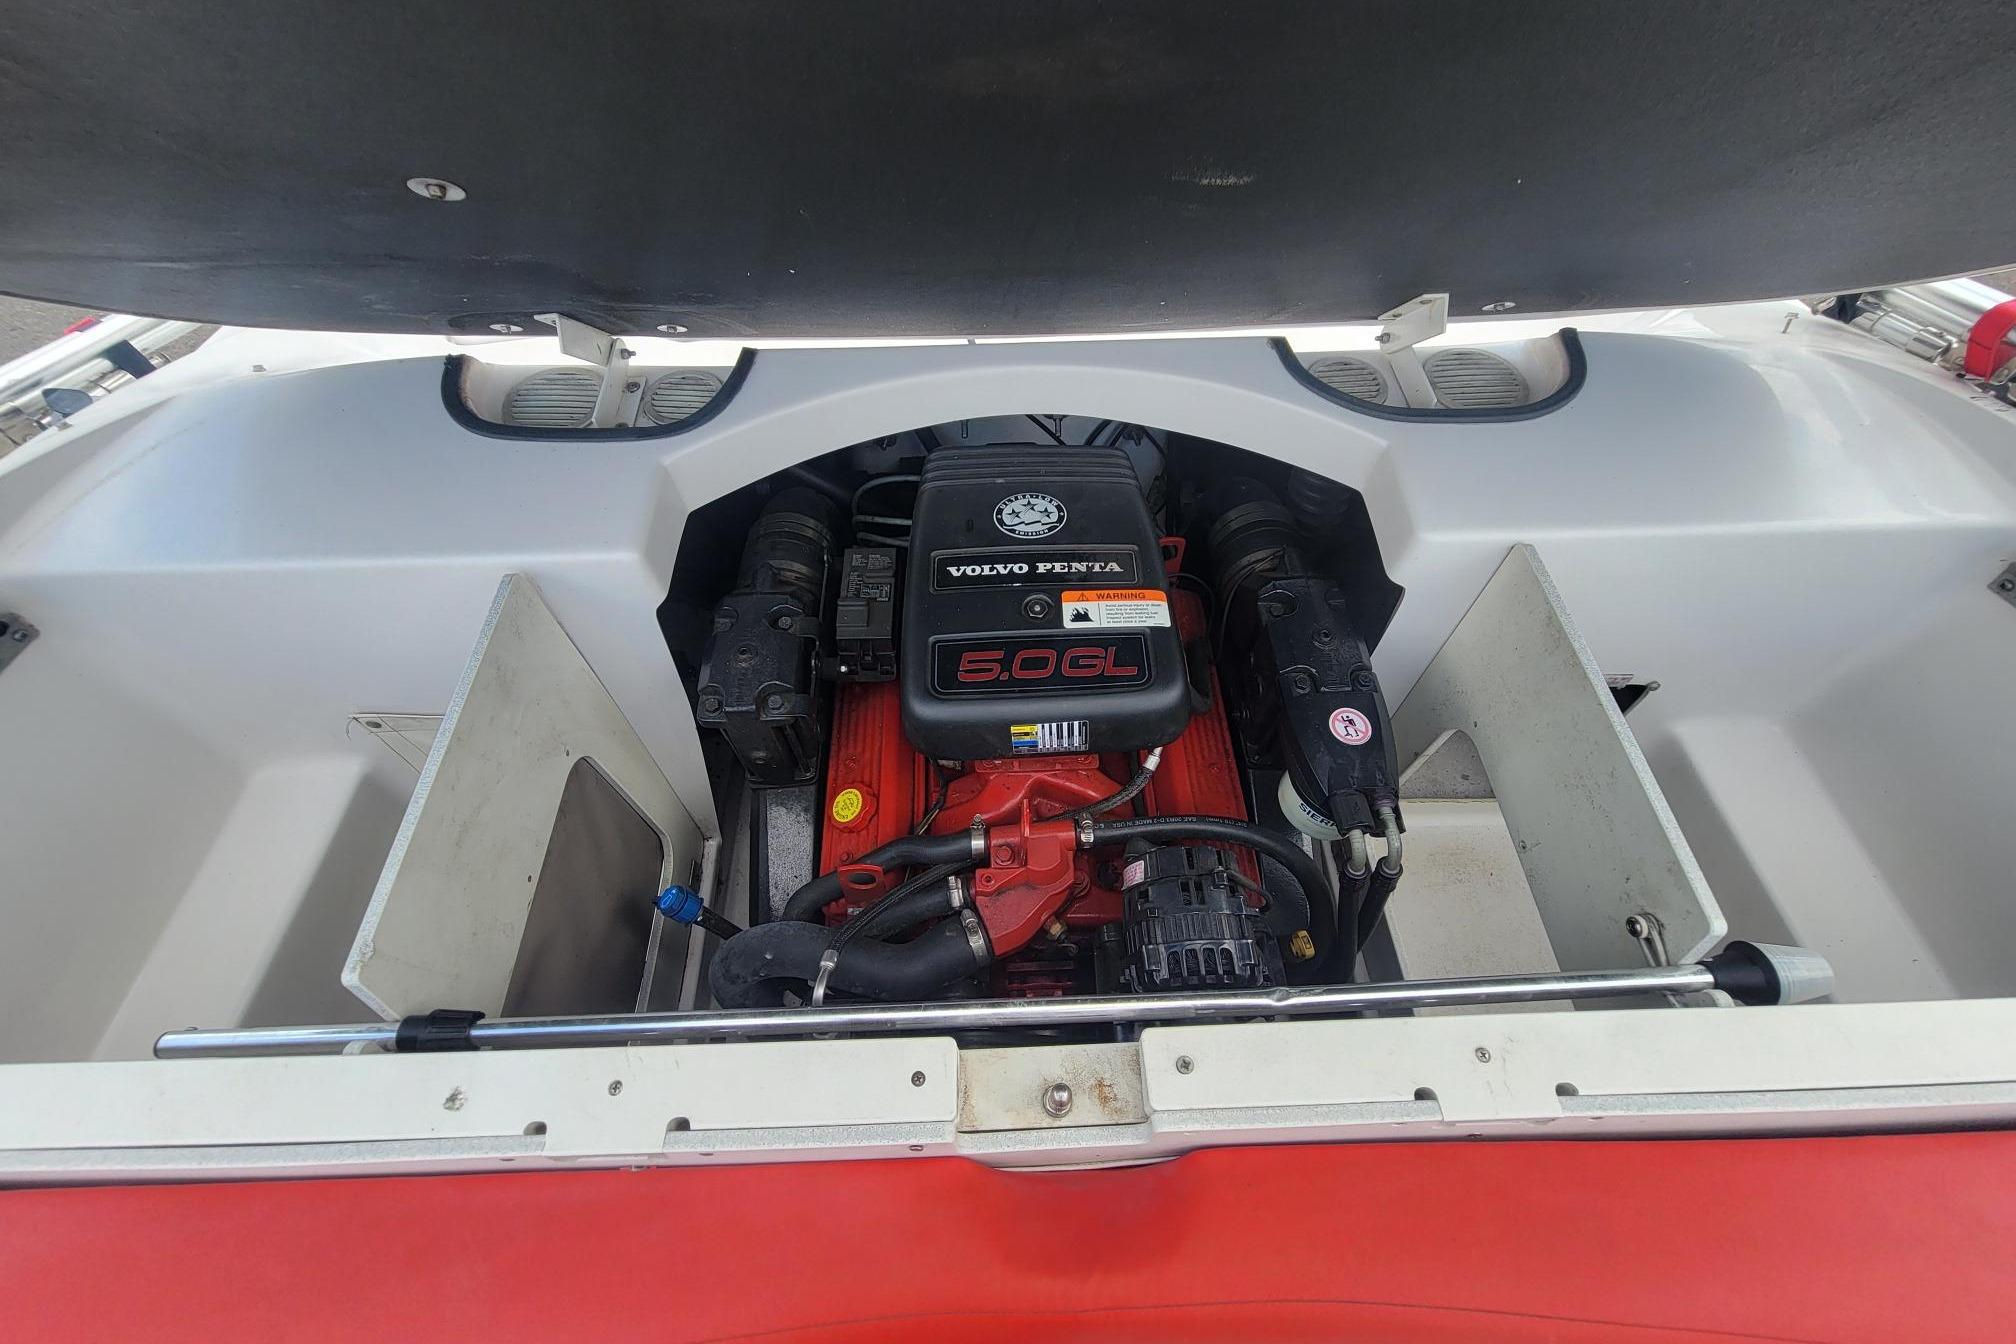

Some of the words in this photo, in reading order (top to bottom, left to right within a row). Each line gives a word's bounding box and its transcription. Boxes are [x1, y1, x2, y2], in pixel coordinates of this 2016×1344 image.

[1000, 495, 1030, 509] ULTRA
[1039, 494, 1059, 506] LOW
[947, 563, 1029, 577] VOLVO
[1036, 561, 1124, 573] PENTA
[1096, 592, 1146, 600] WARNING
